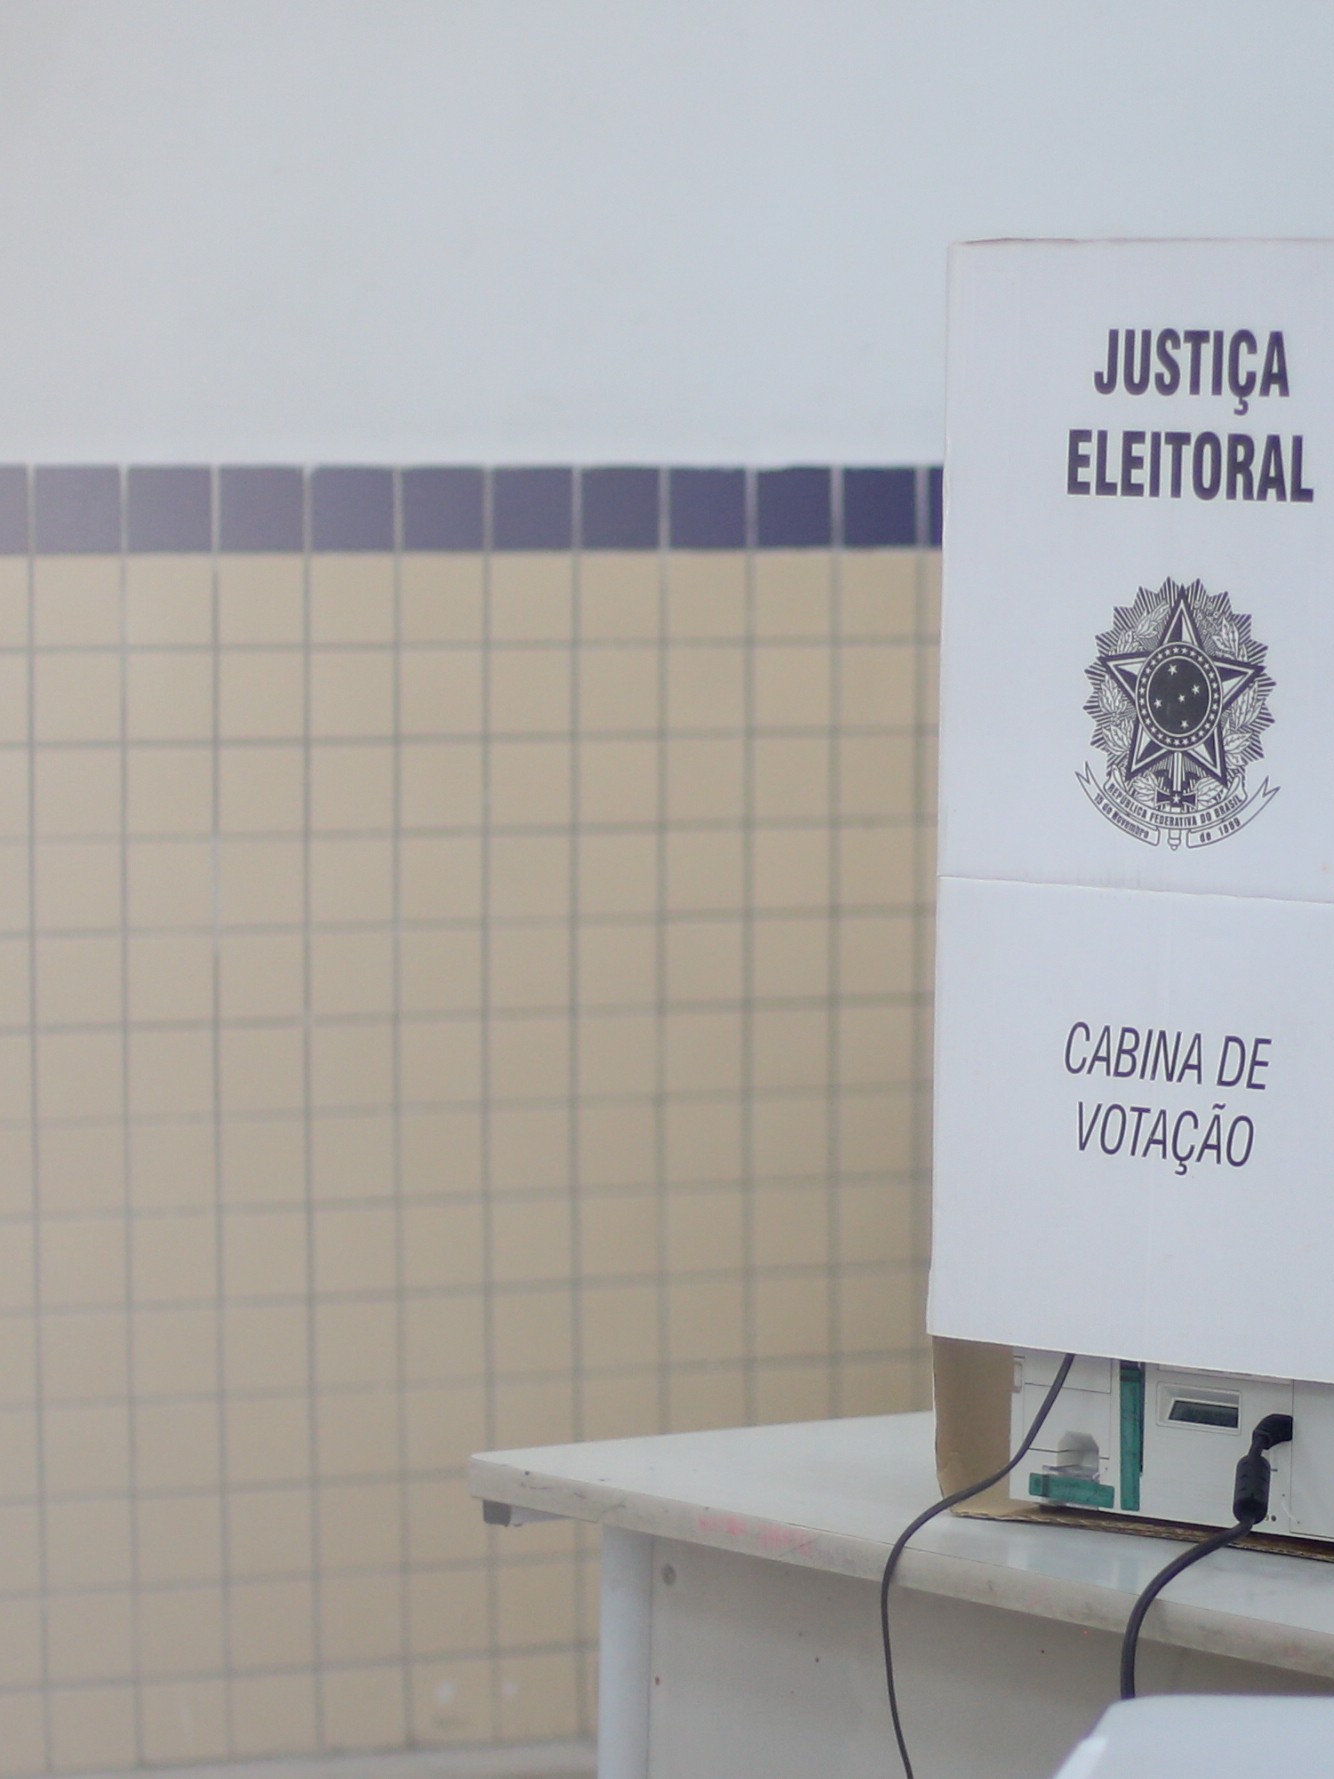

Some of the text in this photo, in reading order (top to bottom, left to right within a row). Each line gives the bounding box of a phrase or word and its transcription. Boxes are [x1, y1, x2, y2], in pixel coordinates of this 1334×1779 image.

[1095, 328, 1290, 416] JUSTIÇA
[1067, 429, 1315, 503] ELEITORAL
[1149, 812, 1197, 827] FEDERATIVA
[1199, 812, 1212, 824] DO
[1214, 794, 1242, 818] BRASIL
[1065, 1021, 1272, 1091] CABINA DE
[1078, 1101, 1254, 1176] VOTAÇÃO
